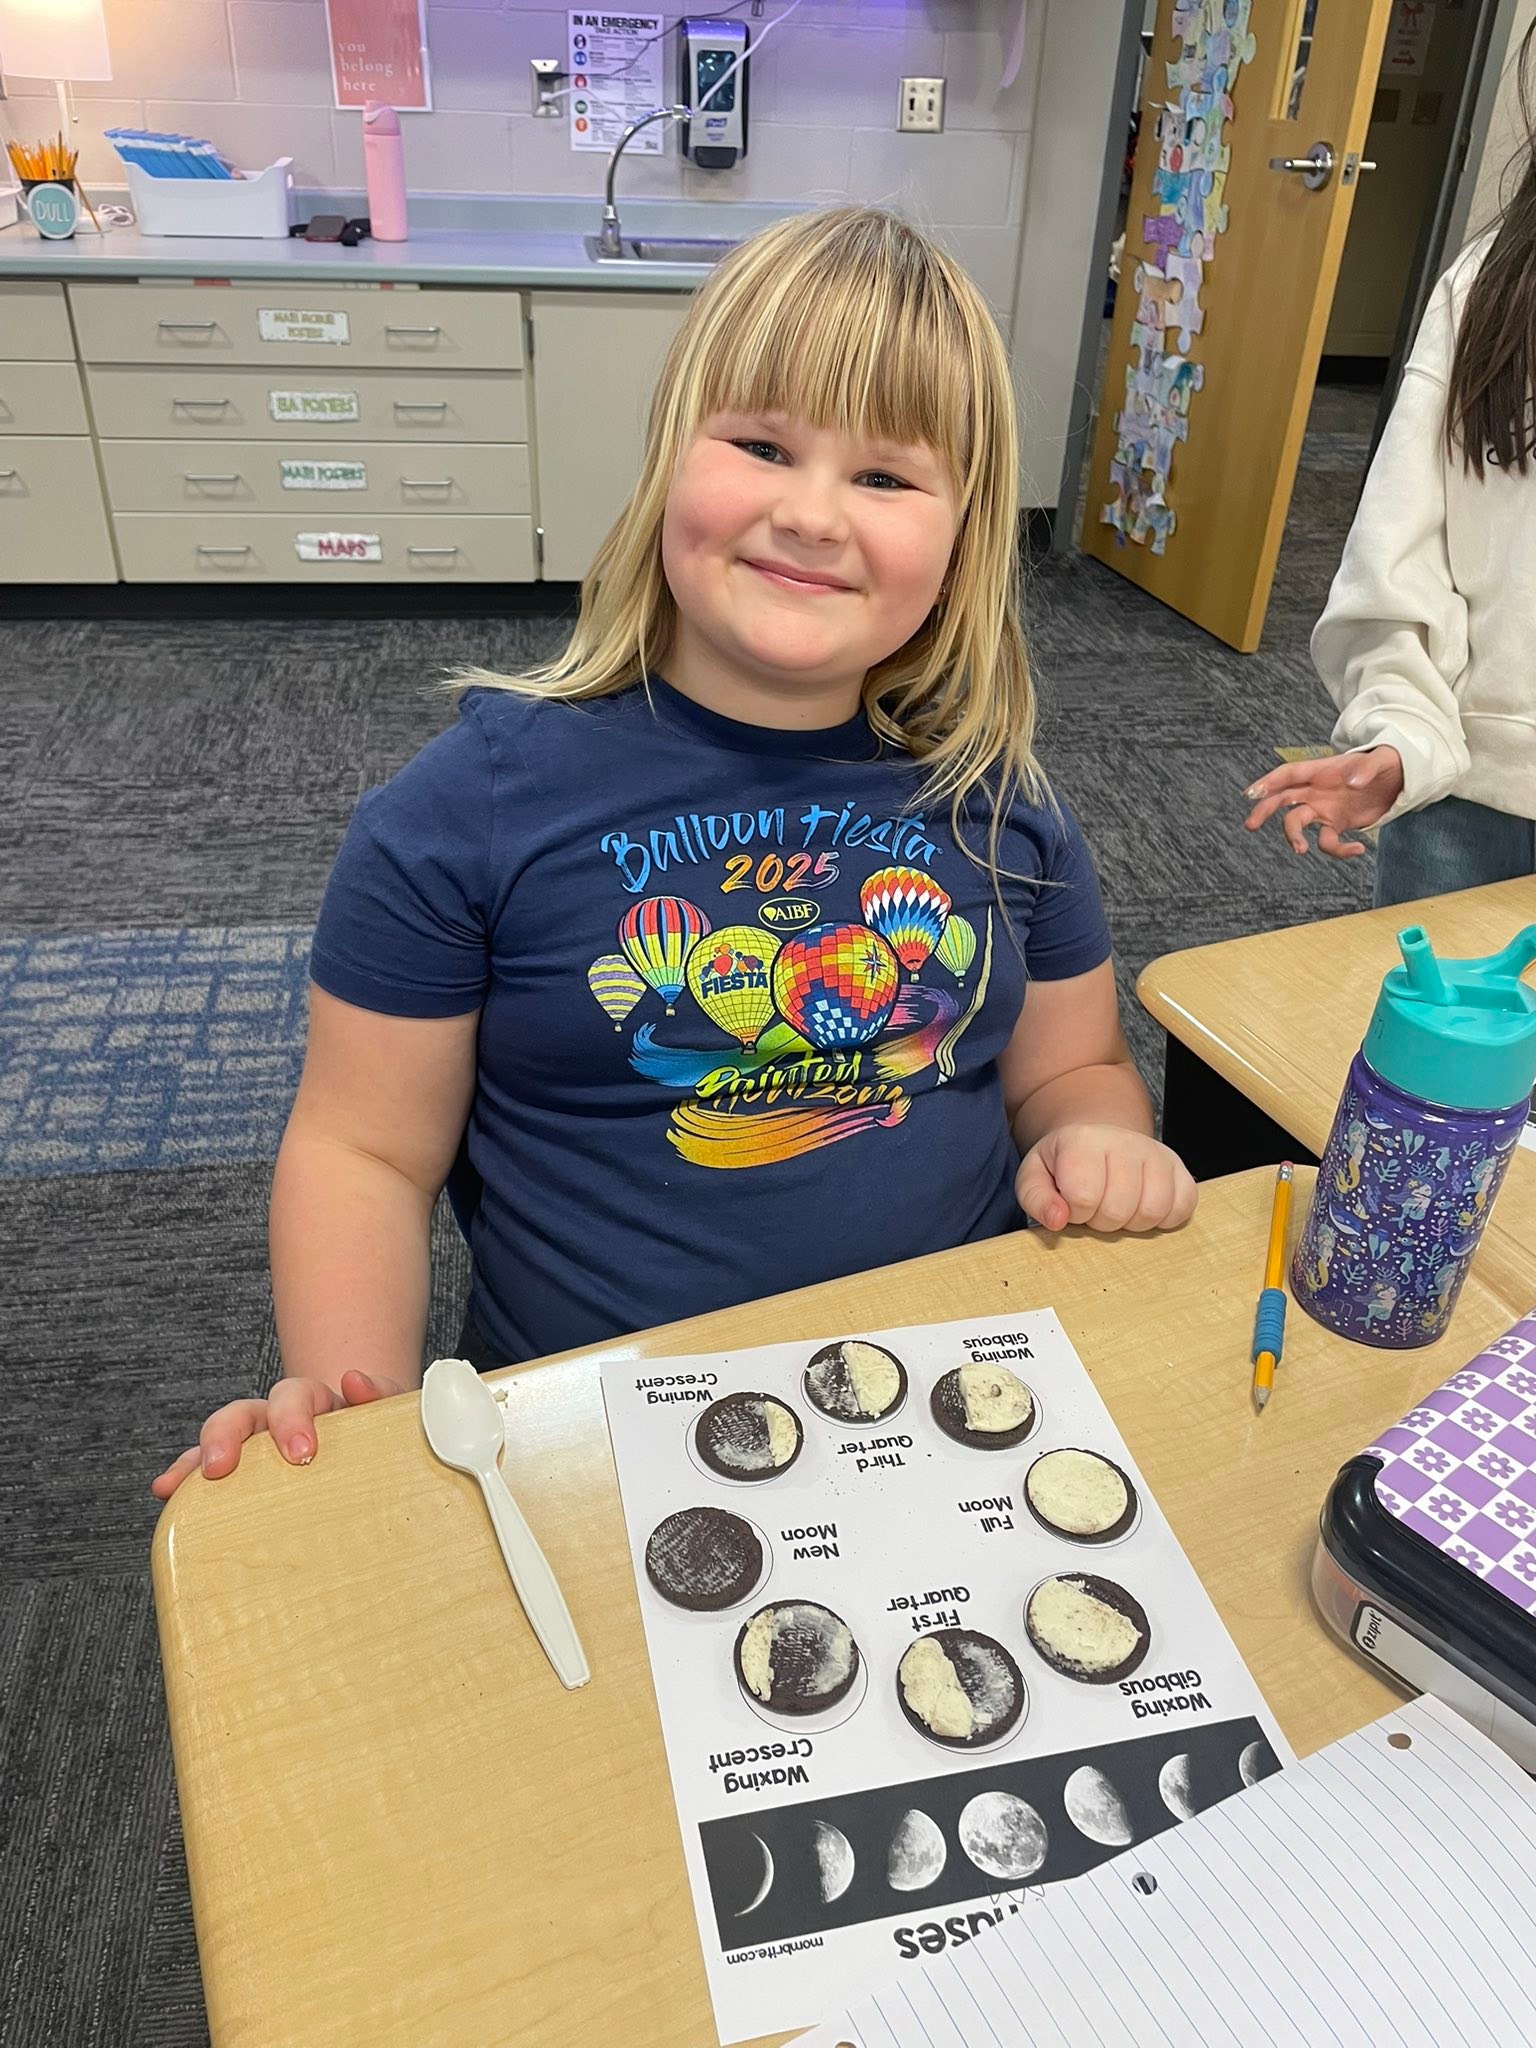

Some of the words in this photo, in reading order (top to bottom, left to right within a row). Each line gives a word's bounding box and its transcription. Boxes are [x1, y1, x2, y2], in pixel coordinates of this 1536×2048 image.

[573, 15, 583, 26] IN
[585, 16, 599, 26] AN
[601, 16, 658, 30] EMERGENCY
[338, 42, 366, 53] you
[339, 54, 394, 77] belong
[342, 76, 377, 91] here
[35, 199, 71, 223] DULL
[318, 540, 368, 557] MAPS
[601, 807, 785, 893] Balloon
[800, 801, 940, 866] Fiesta
[720, 851, 840, 894] 2025
[775, 902, 814, 922] AIBF
[701, 971, 769, 1000] FIESTA
[962, 1332, 1030, 1349] Gibbous
[971, 1346, 1035, 1363] Waning
[635, 1372, 718, 1391] Crescent
[647, 1389, 714, 1404] Waning
[837, 1434, 914, 1455] Quarter
[856, 1452, 906, 1473] Third
[958, 1495, 1014, 1513] Moon
[781, 1523, 838, 1542] Moon
[980, 1514, 1015, 1533] Full
[793, 1542, 840, 1560] New
[886, 1585, 971, 1613] Quarter
[912, 1608, 961, 1632] First
[1119, 1669, 1202, 1696] Gibbous
[1131, 1691, 1213, 1719] Waxing
[709, 1738, 813, 1774] Crescent
[723, 1764, 810, 1795] Waxing
[726, 1936, 824, 1965] mombrite.com
